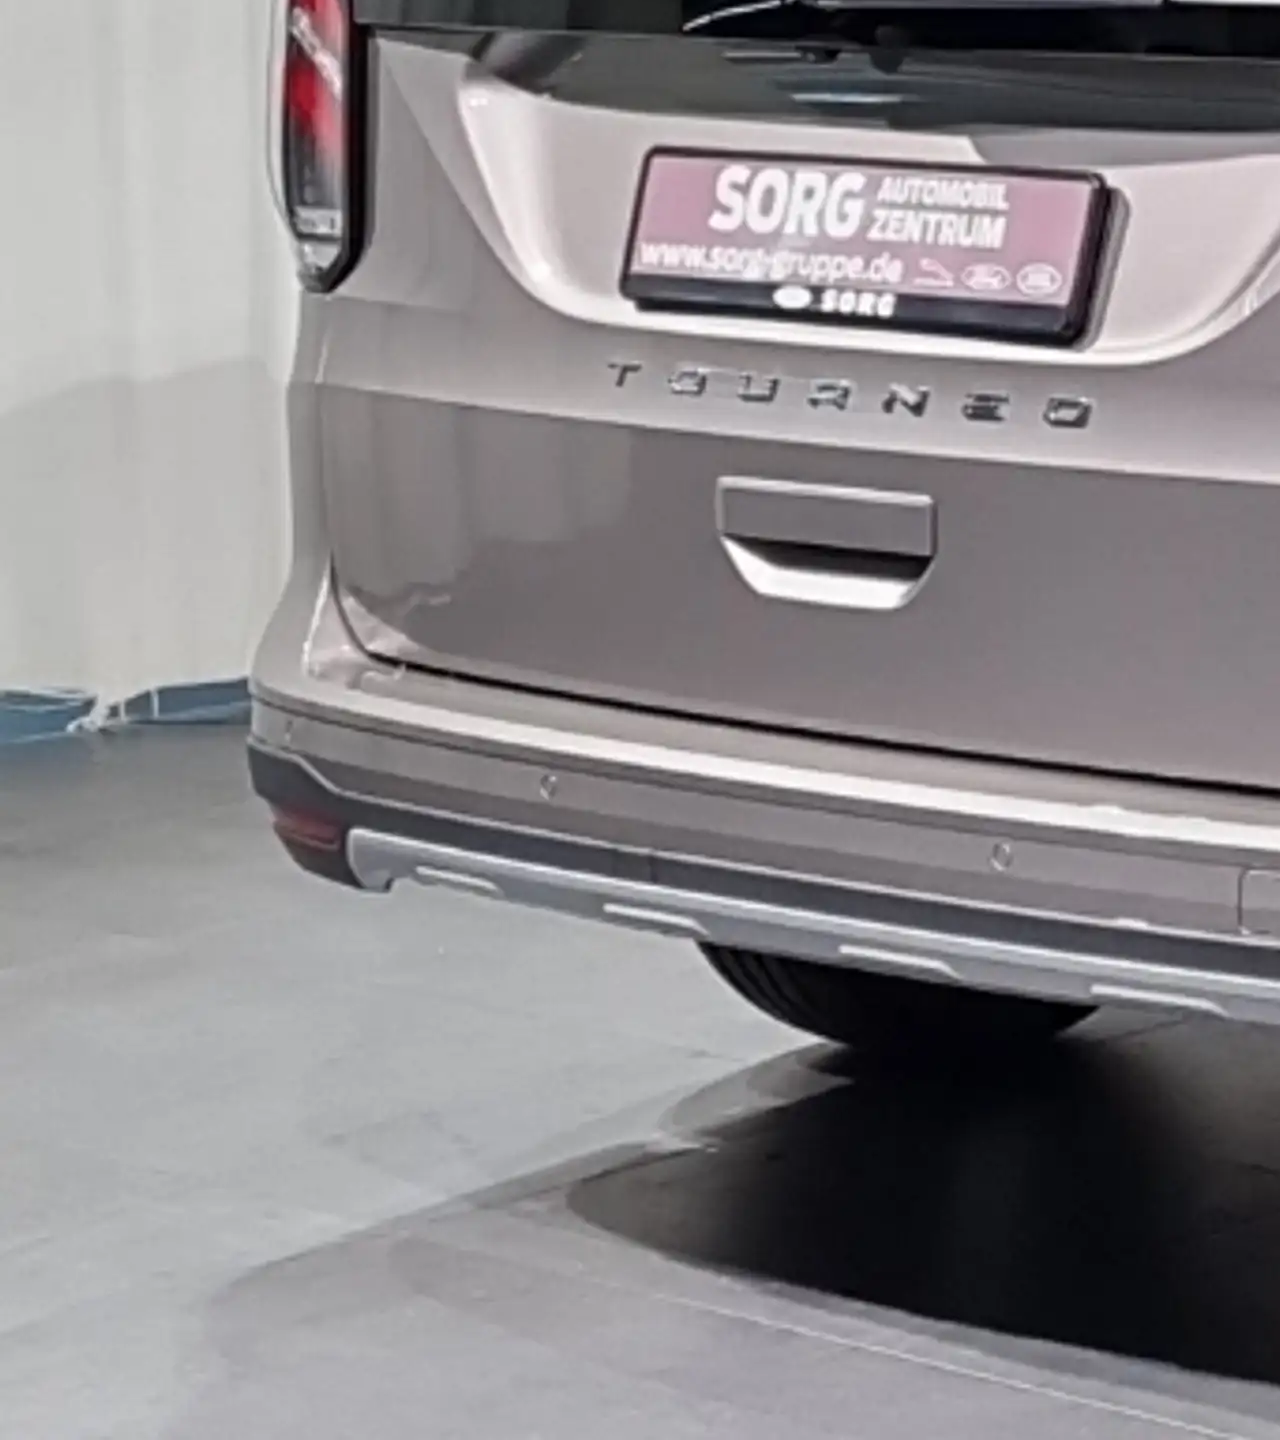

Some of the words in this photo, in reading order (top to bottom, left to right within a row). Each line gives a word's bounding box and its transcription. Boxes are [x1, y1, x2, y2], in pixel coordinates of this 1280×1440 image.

[708, 165, 867, 239] SORG
[877, 176, 1009, 210] AUTOMOBIL
[867, 208, 1006, 249] ZENTRUM
[641, 243, 904, 284] www.sorg-gruppe.de
[820, 288, 896, 319] SORG
[607, 362, 1093, 428] TOURNEO
